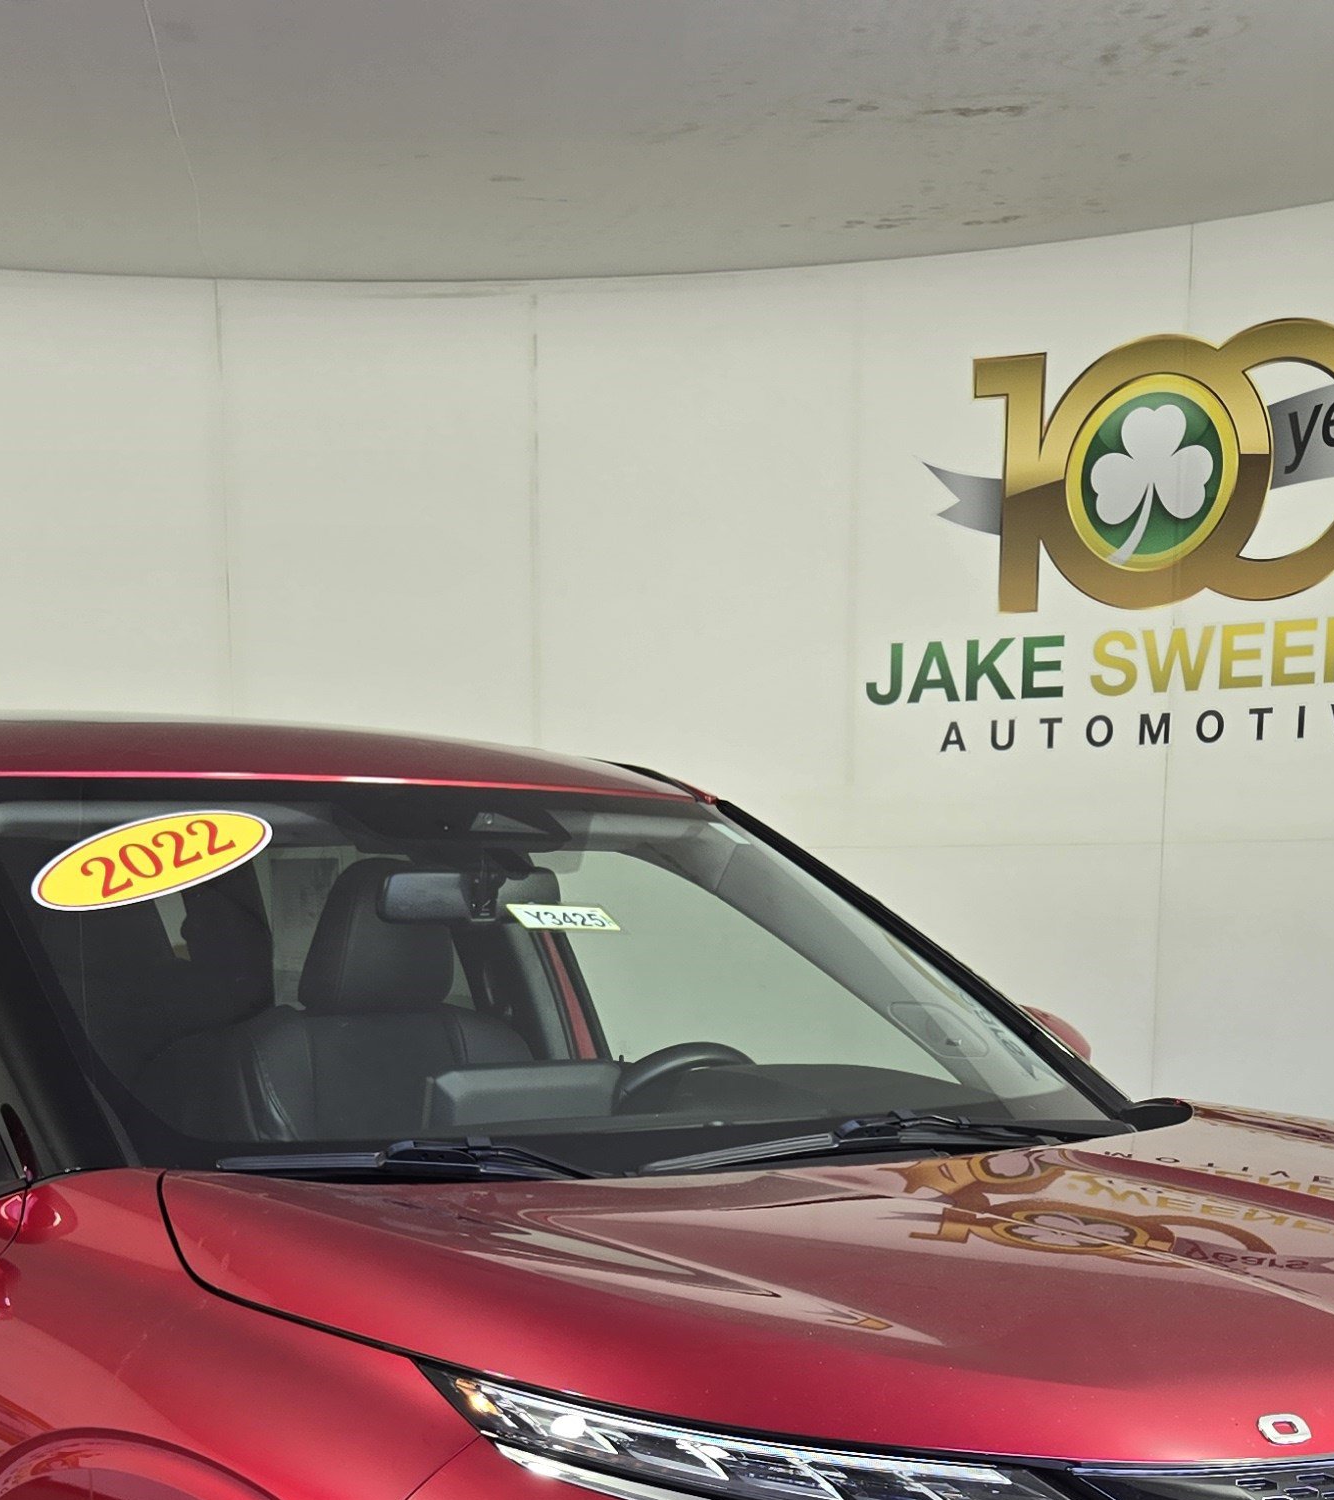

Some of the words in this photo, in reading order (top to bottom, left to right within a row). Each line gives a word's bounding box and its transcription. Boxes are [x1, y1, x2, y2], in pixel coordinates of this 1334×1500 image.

[866, 634, 1065, 706] JAKE
[80, 819, 237, 898] 2022
[524, 910, 606, 927] Y3425
